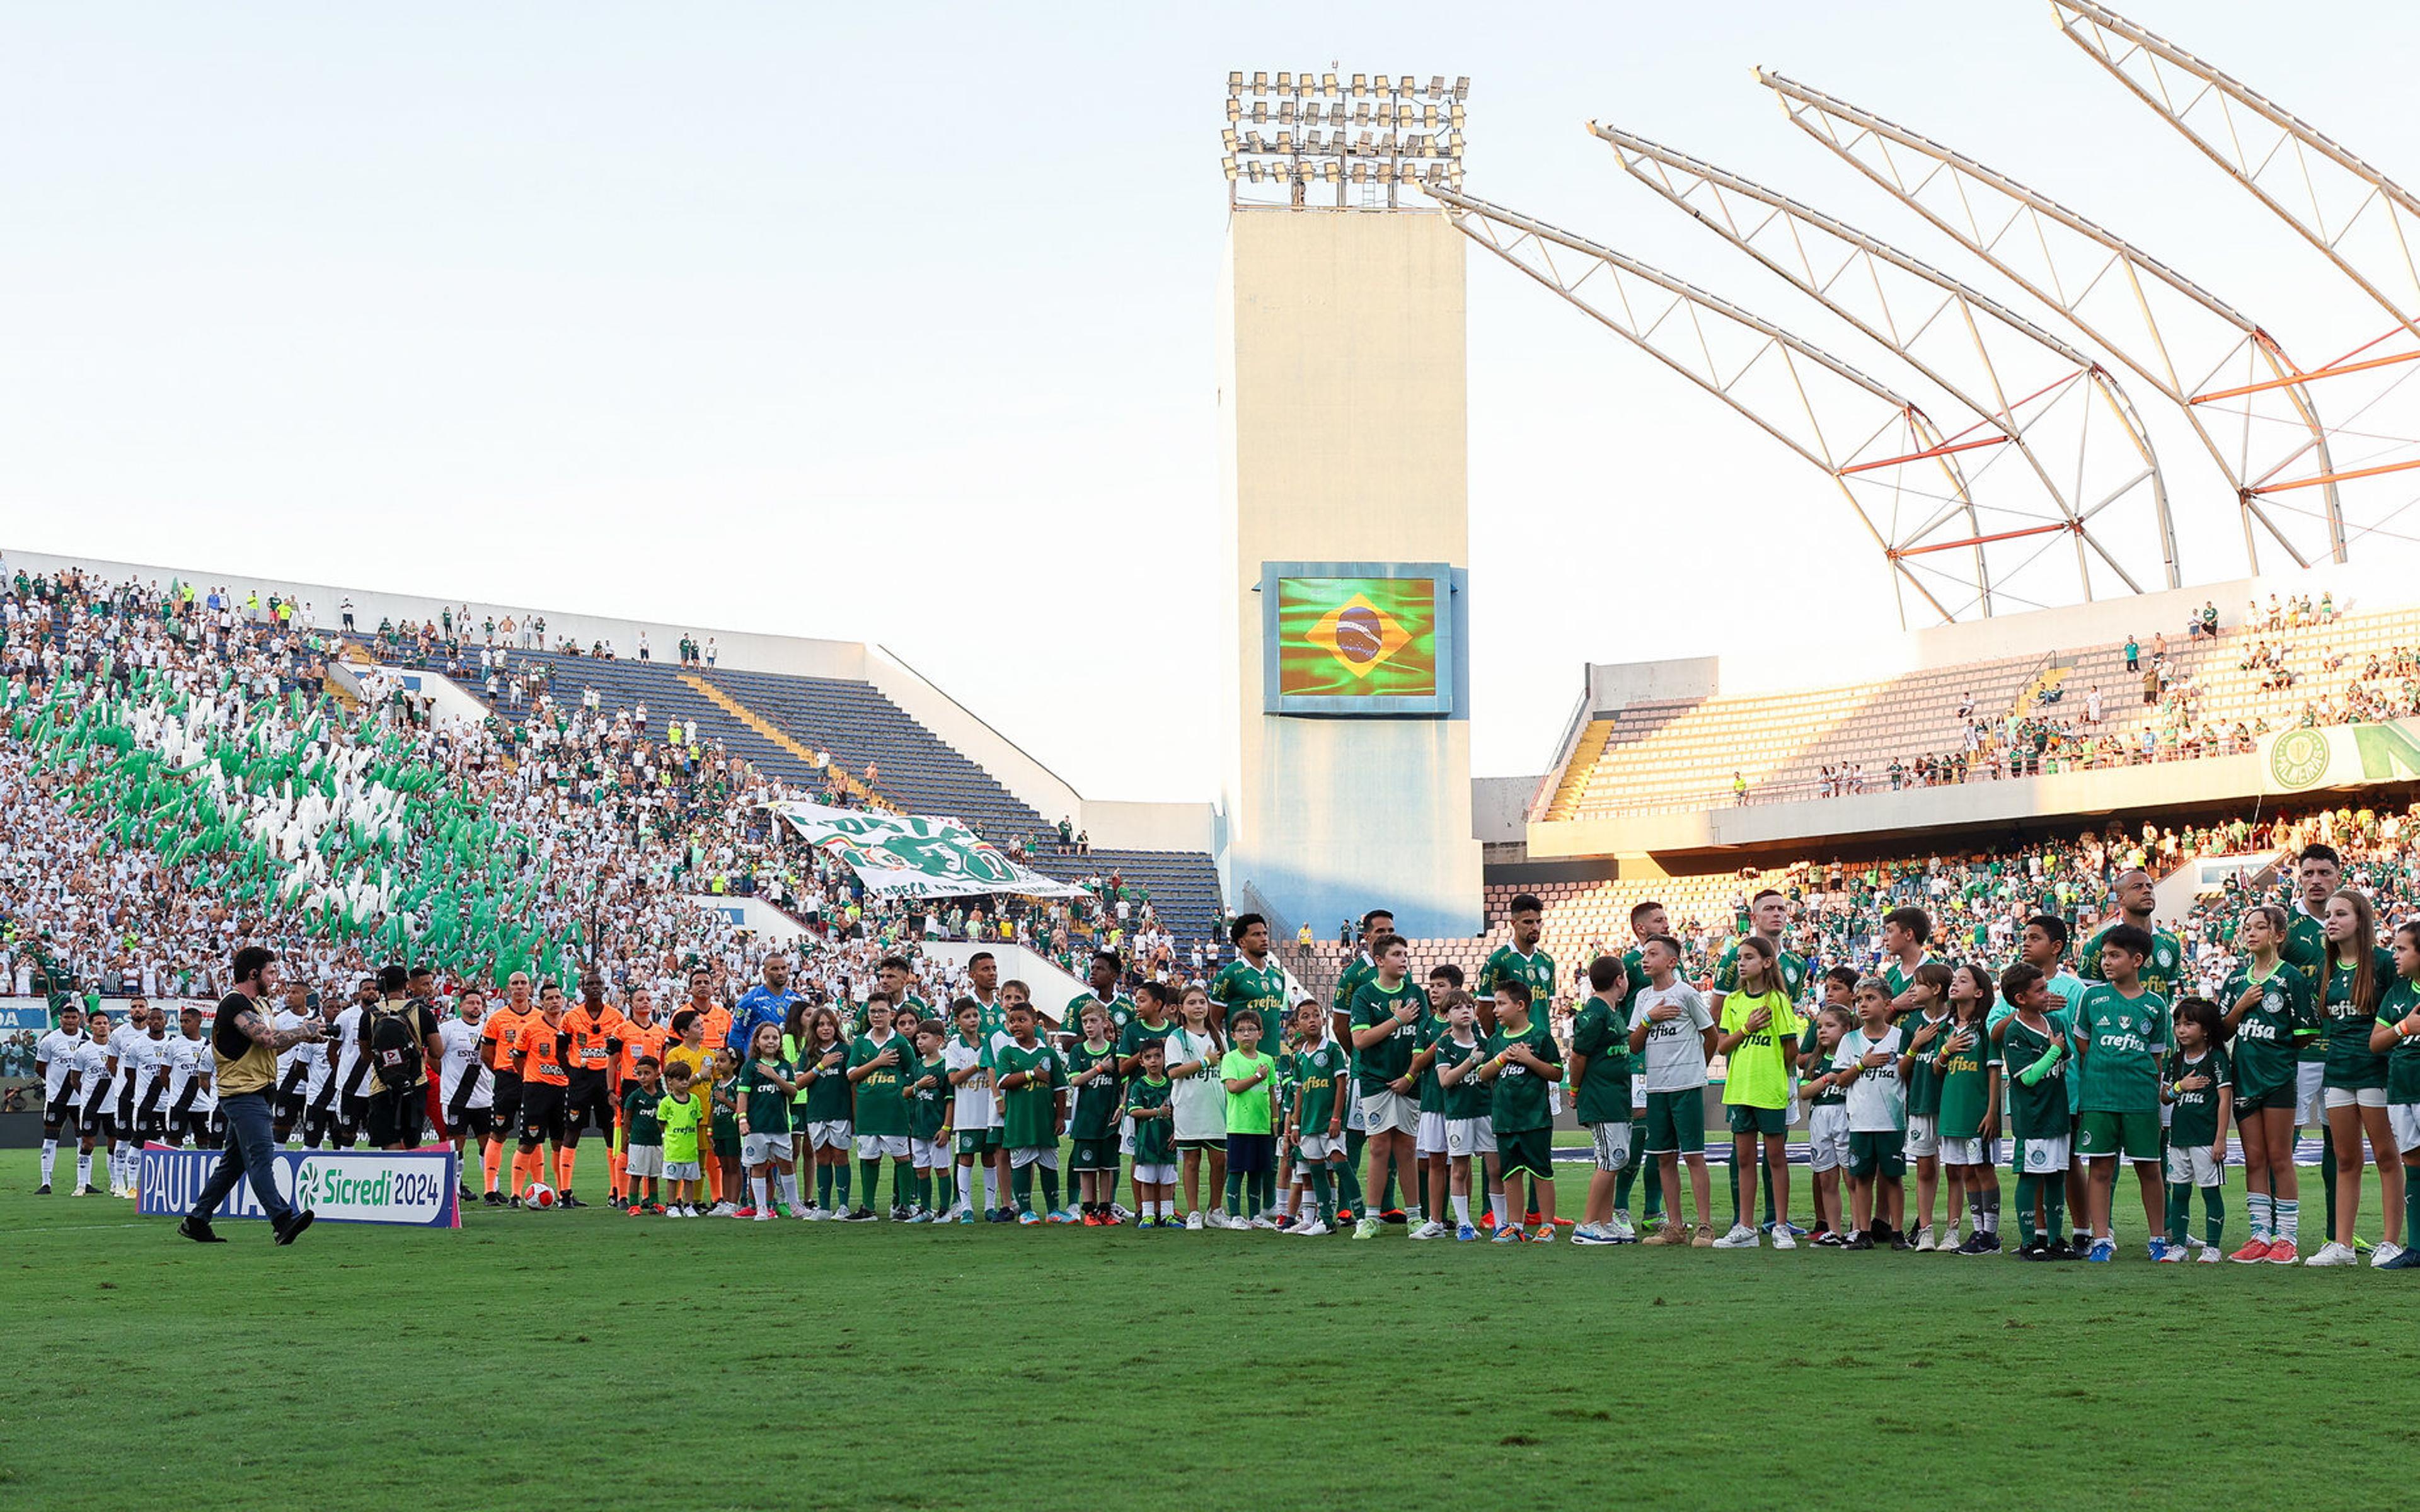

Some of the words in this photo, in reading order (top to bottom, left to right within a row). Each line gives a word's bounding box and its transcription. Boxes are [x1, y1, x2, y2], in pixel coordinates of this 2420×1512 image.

[2100, 1033, 2145, 1051] crefisa
[1500, 1063, 1525, 1078] efisa
[322, 1169, 392, 1206] Sicredi
[394, 1172, 439, 1206] 2024
